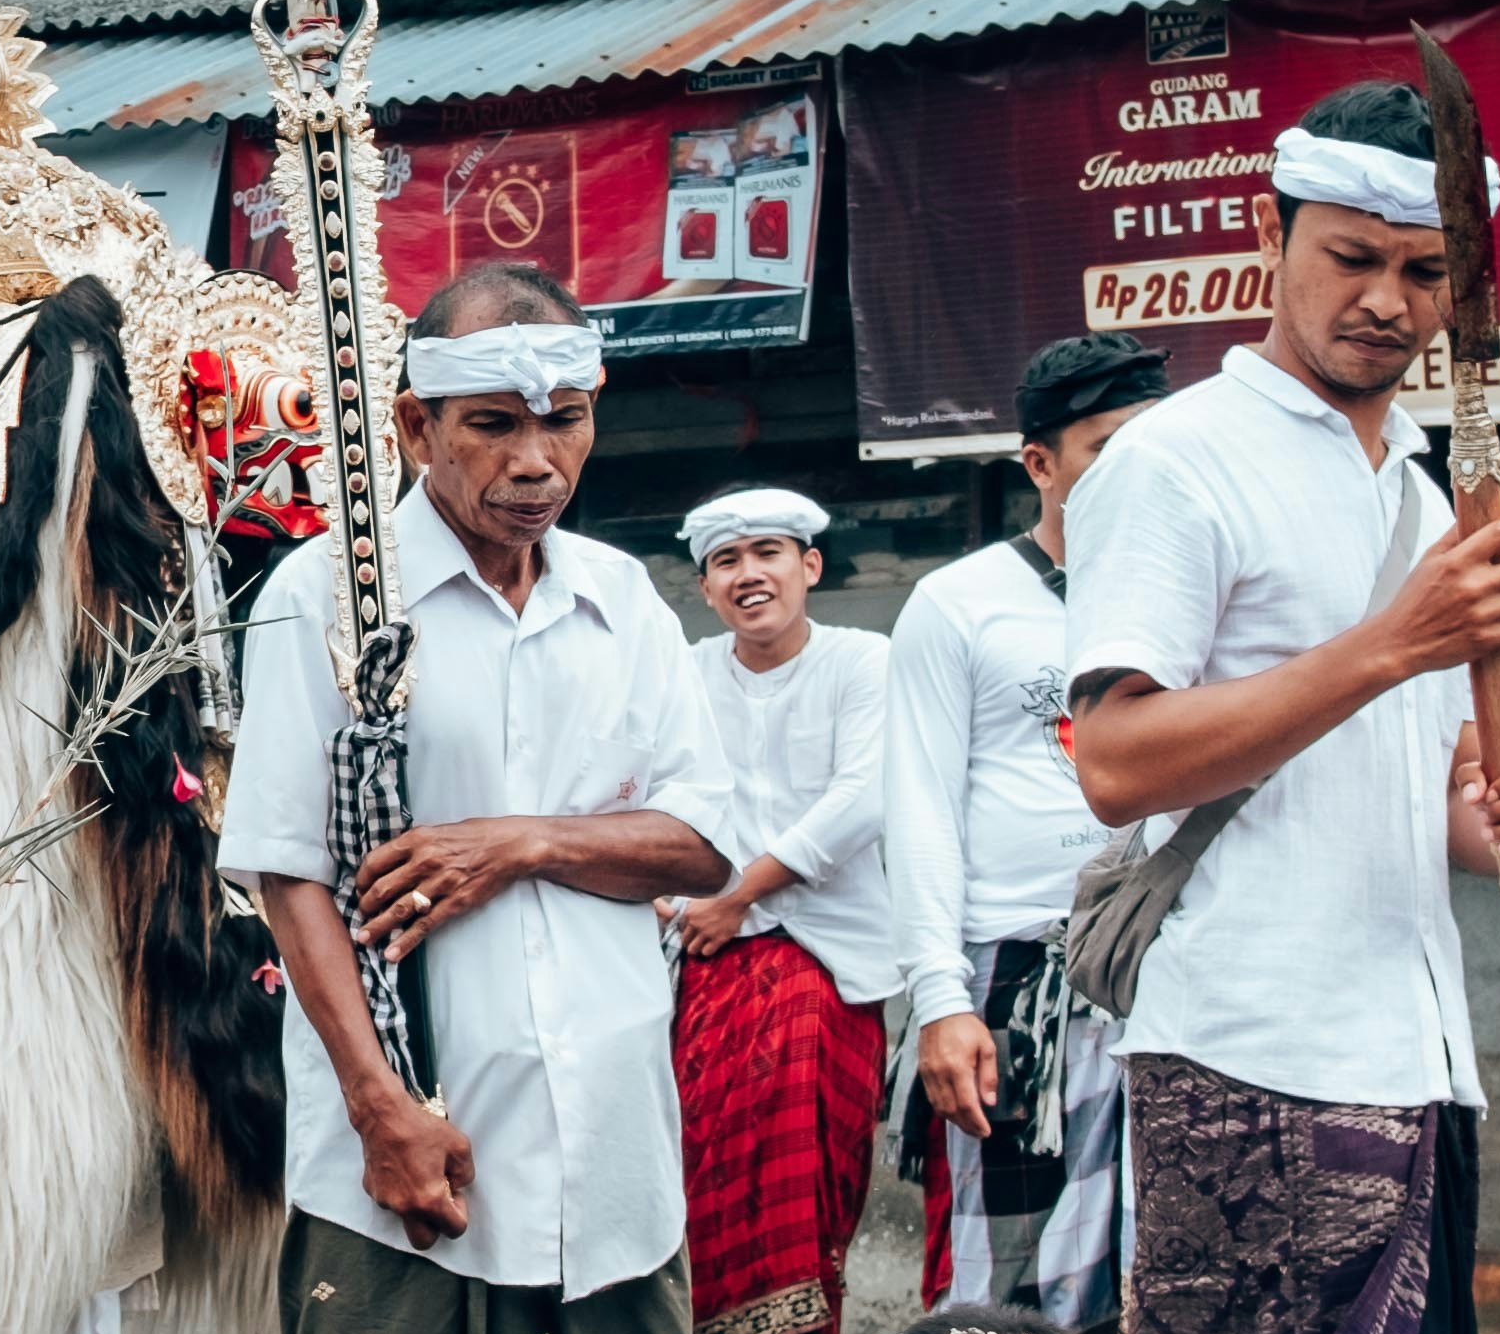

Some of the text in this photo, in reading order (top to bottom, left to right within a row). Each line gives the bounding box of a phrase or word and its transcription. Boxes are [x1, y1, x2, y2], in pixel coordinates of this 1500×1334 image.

[1150, 73, 1228, 95] GUDANG
[1118, 88, 1262, 132] GARAM
[455, 145, 486, 181] NEW
[1113, 196, 1261, 241] FILTE
